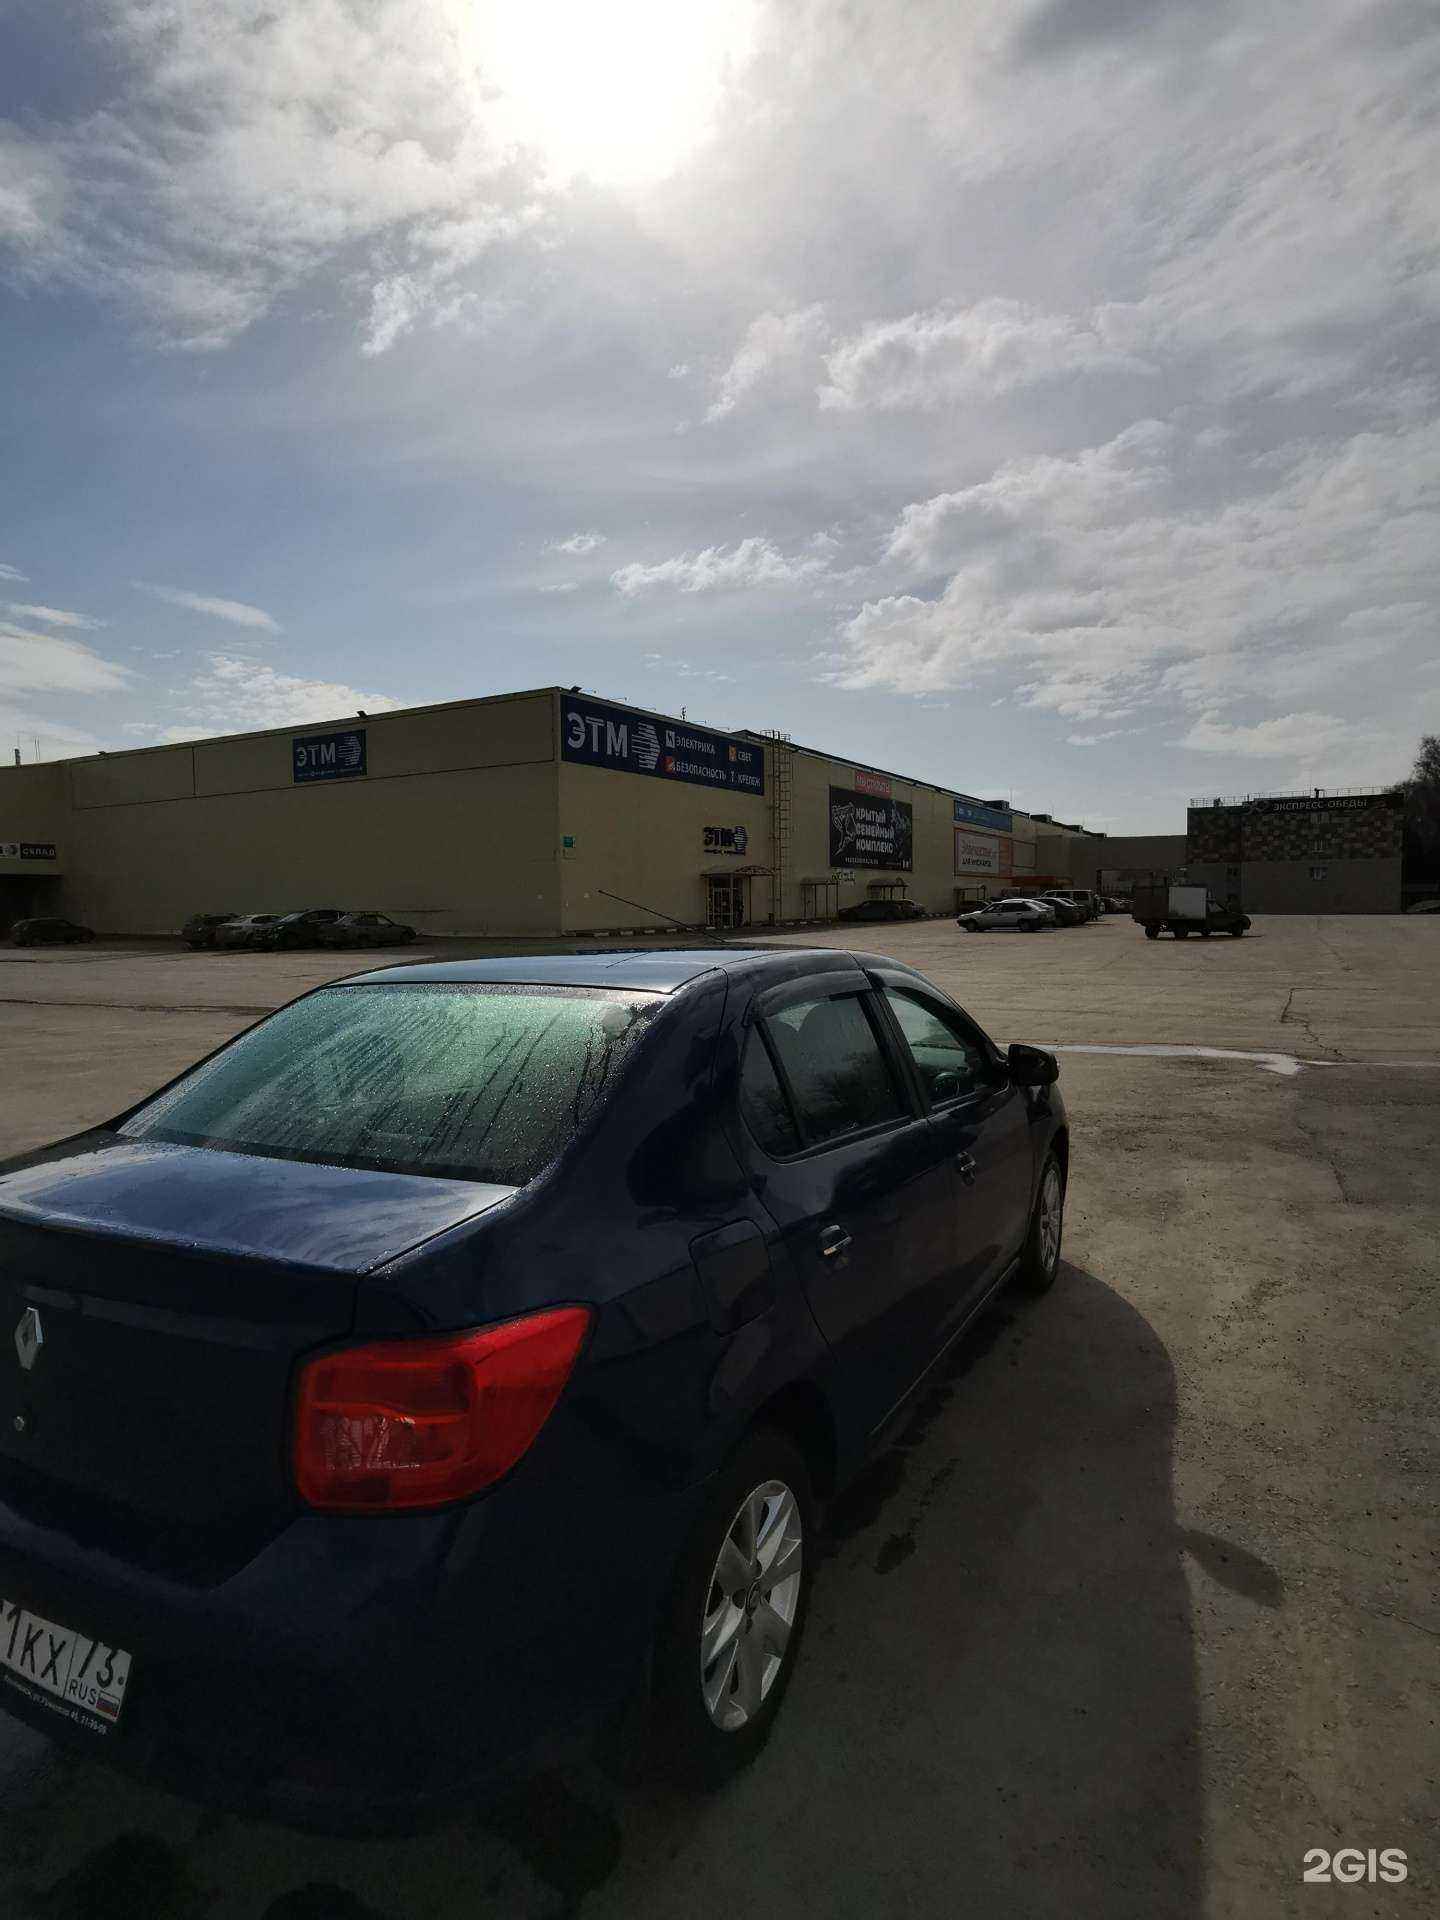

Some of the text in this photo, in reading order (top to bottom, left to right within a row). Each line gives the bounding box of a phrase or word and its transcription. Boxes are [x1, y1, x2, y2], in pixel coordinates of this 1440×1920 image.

[566, 711, 629, 759] ЭТМ
[675, 735, 716, 755] ЭЛЕКТРИКА
[295, 742, 336, 767] ЭТМ
[737, 751, 753, 762] СВЕТ
[676, 761, 727, 780] БЕЗОПАСНОСТЬ
[737, 773, 761, 787] КРЕПЕЖ
[1272, 799, 1369, 811] ЭКСПРЕСС ОБЕДЫ
[855, 807, 886, 823] КРЫТЫЙ
[855, 823, 895, 839] СЕМЕЙНЫЙ
[855, 838, 894, 854] КОМПЛЕКС
[68, 1678, 97, 1705] RUS
